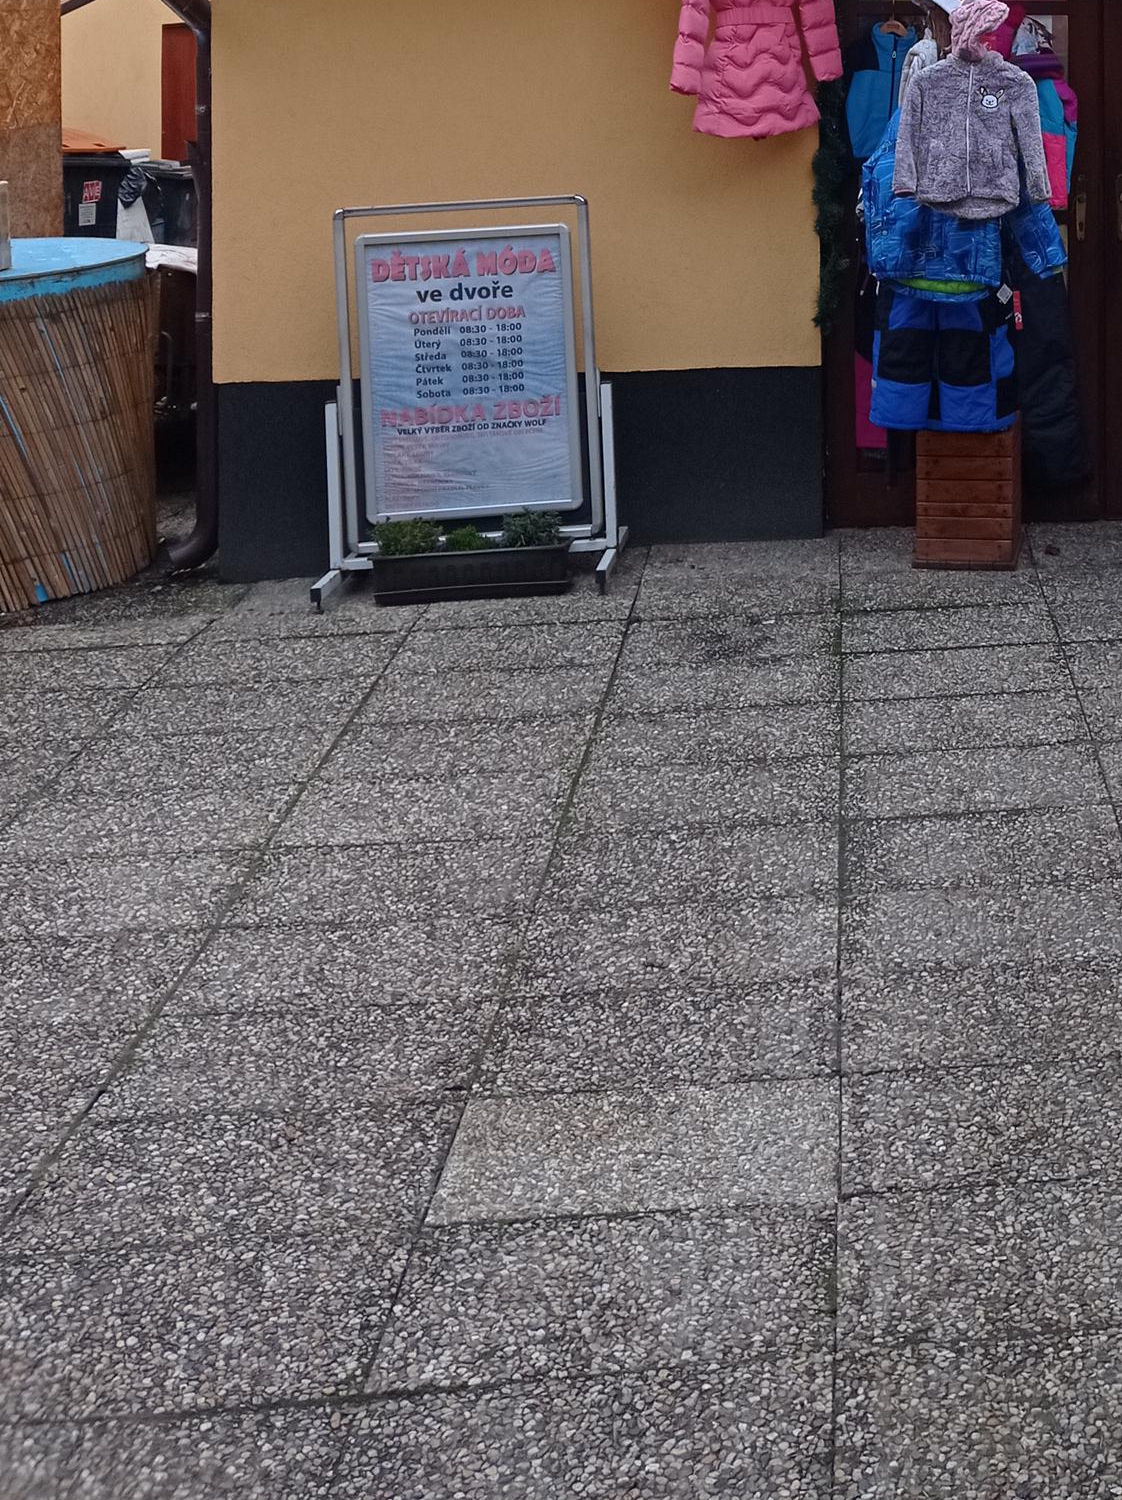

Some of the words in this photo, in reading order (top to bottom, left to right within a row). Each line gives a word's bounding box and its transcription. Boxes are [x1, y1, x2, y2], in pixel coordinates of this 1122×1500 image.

[370, 248, 471, 283] DĚTSKÁ
[475, 244, 557, 277] MÓDA
[416, 289, 443, 303] ve
[449, 281, 514, 301] dvoře
[408, 305, 483, 325] OTEVÍRACÍ
[486, 305, 527, 320] DOBA
[460, 325, 487, 334] 08:30
[496, 323, 522, 332] 18:00
[460, 337, 487, 347] 08:30
[496, 335, 522, 344] 18:00
[415, 352, 447, 362] Středa
[461, 350, 488, 359] 08:30
[497, 347, 523, 357] 18:00
[415, 363, 453, 374] Čtvrtek
[461, 361, 489, 371] 08:30
[497, 359, 524, 369] 18:00
[416, 376, 444, 387] Pátek
[462, 374, 489, 383] 08:30
[498, 371, 524, 381] 18:00
[416, 389, 452, 399] Sobota
[462, 386, 490, 396] 08:30
[499, 384, 525, 393] 18:00
[380, 403, 486, 428] NABÍDKA
[493, 394, 562, 421] ZBOŽÍ
[397, 425, 424, 436] VELKÝ
[451, 422, 475, 433] ZBOŽÍ
[477, 422, 489, 432] OD
[491, 420, 522, 430] ZNAČKY
[524, 418, 547, 428] WOLF
